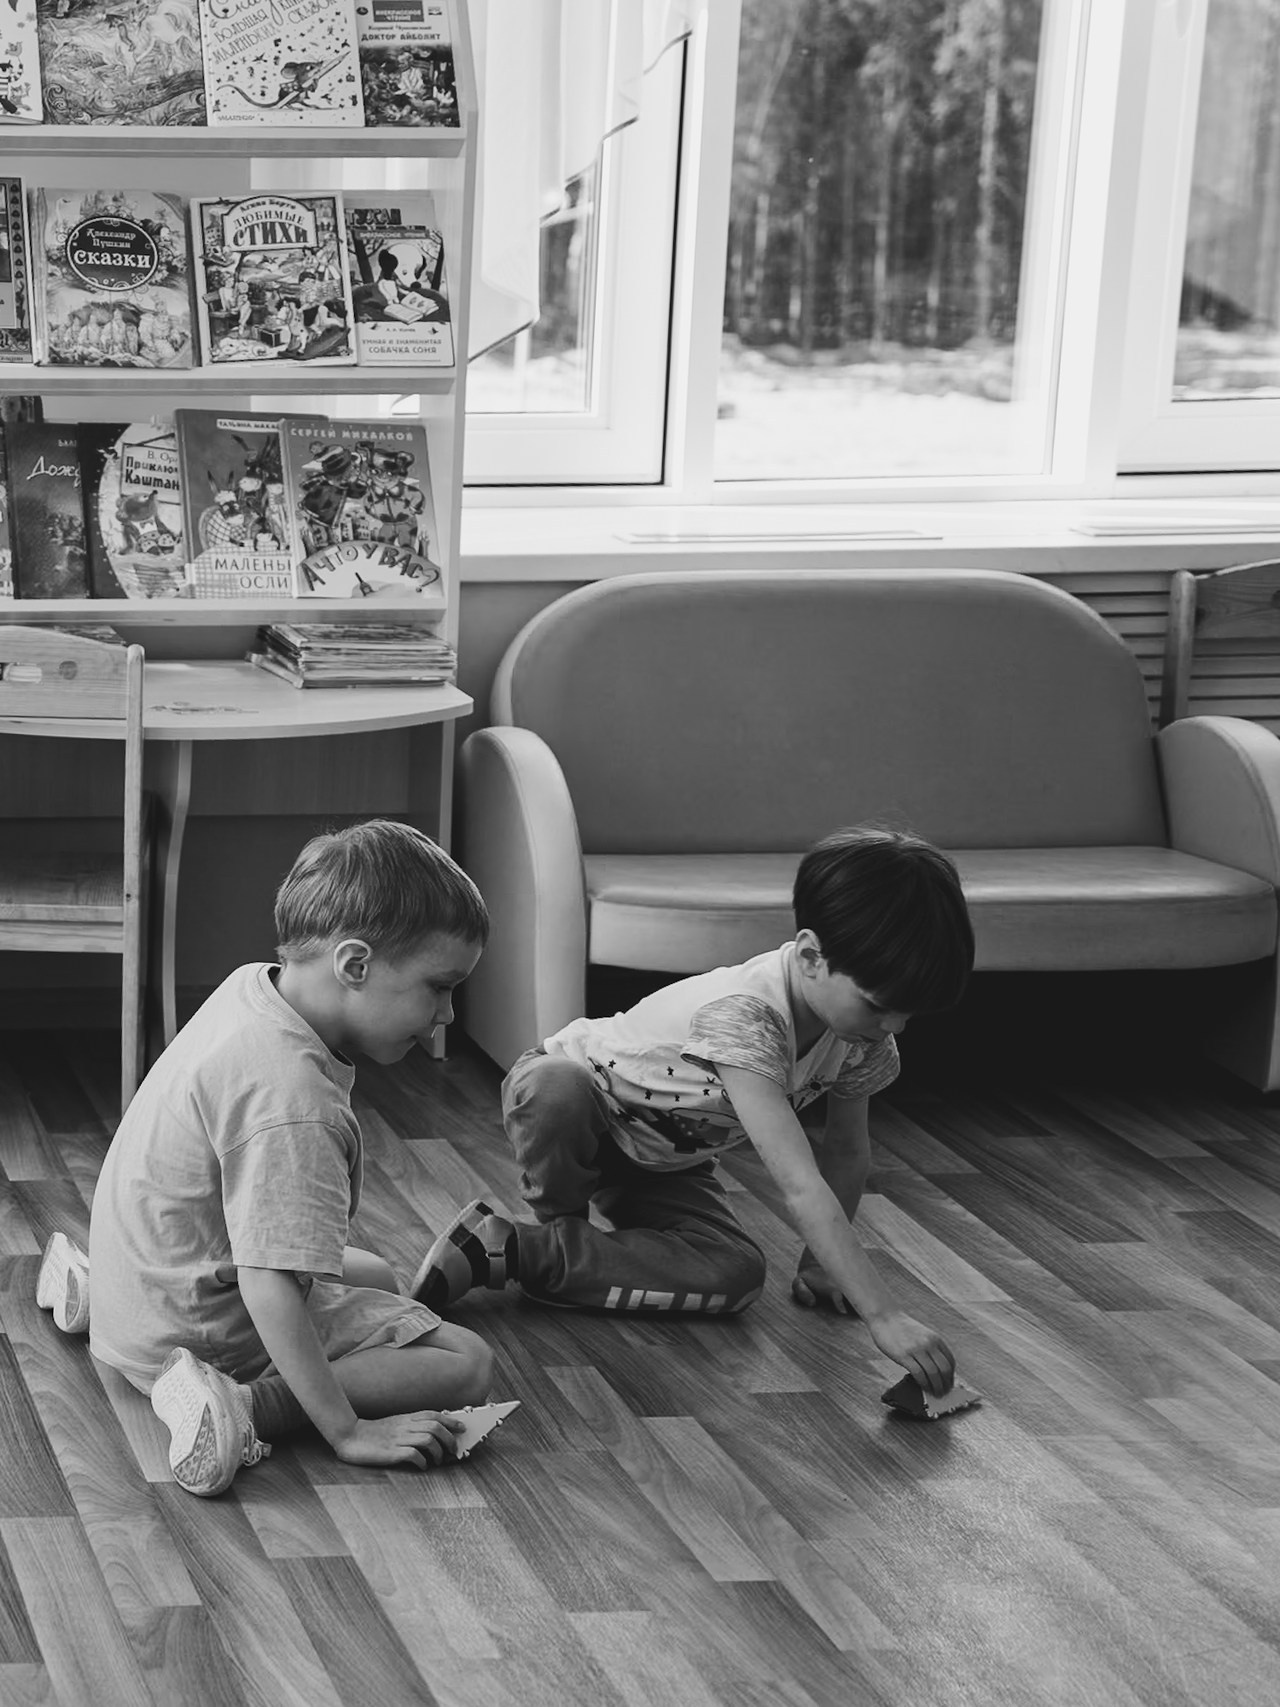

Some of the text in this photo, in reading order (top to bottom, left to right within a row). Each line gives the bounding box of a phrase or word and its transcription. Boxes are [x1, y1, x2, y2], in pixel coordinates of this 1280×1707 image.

[361, 32, 441, 41] ДОКТОР АЙБОЛИТ
[234, 210, 305, 229] ЛЮБИМЫЕ
[233, 221, 309, 247] СТИХИ
[369, 346, 437, 354] СОБАЧКА СОНЯ
[291, 428, 414, 442] СЕРГЕЙ МИХАЛКОВ
[124, 468, 181, 491] Каштан
[214, 558, 291, 571] МАЛЕНЬ
[302, 563, 326, 591] А
[314, 545, 359, 572] ЧТО
[362, 543, 379, 559] У
